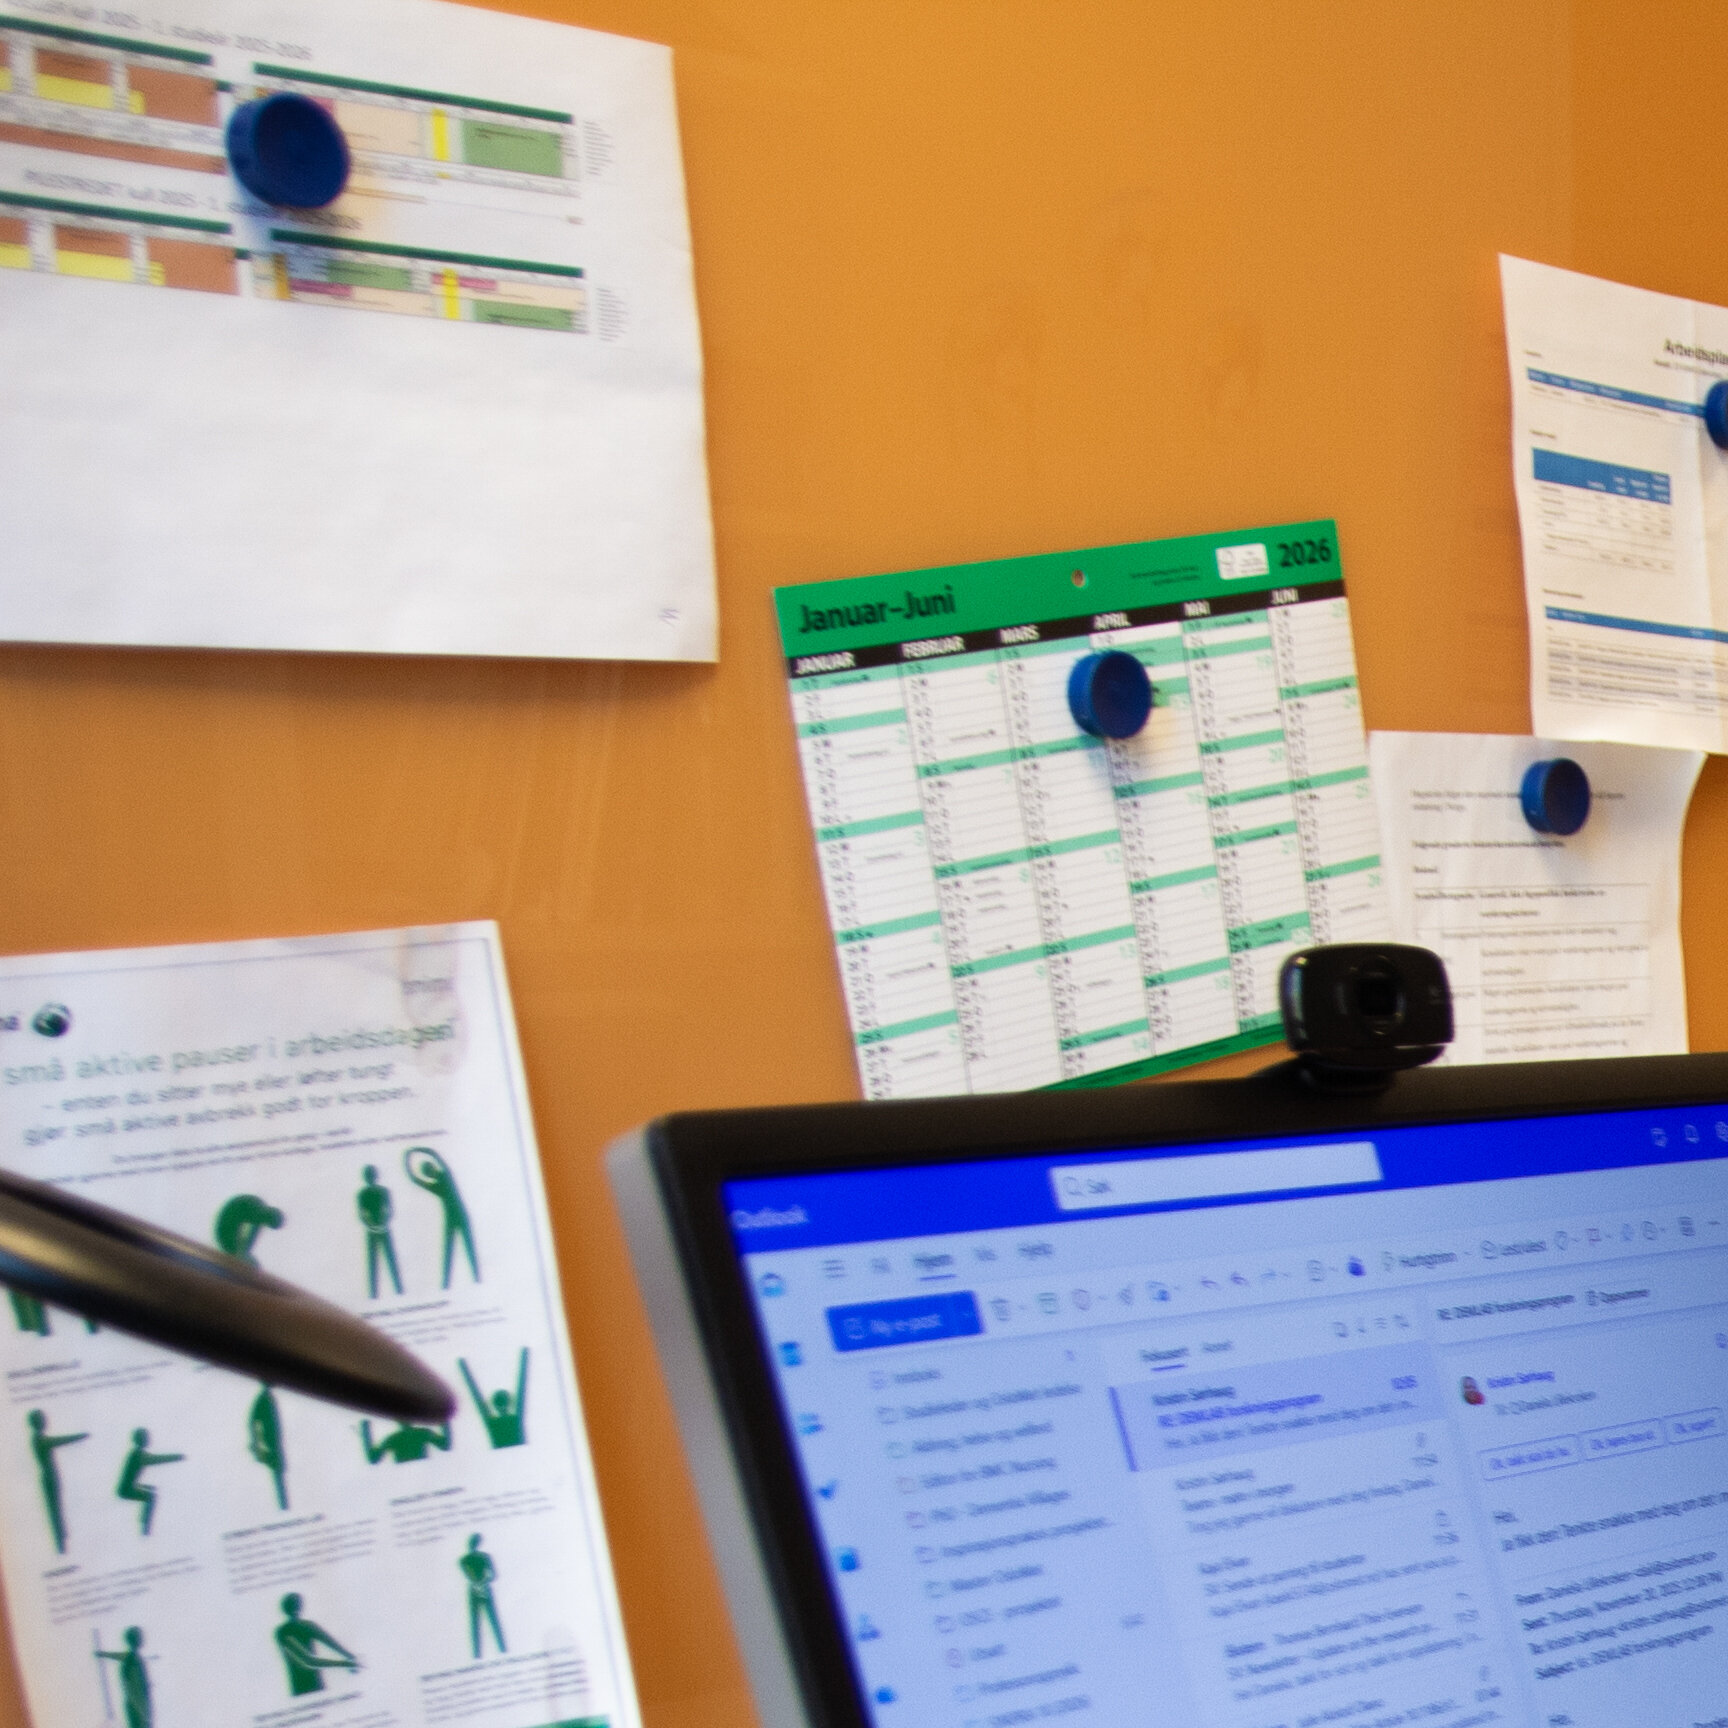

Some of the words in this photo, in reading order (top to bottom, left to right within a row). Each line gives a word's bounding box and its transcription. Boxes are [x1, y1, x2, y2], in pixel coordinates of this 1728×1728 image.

[1278, 538, 1333, 569] 2026
[796, 651, 857, 675] JANUAR
[901, 635, 966, 659] FEBRUAR
[999, 624, 1041, 644] MARS
[1093, 612, 1132, 631] APRIL
[1184, 601, 1211, 617] MAI
[1272, 587, 1299, 605] JUNI
[4, 1056, 66, 1085] små
[75, 1051, 162, 1079] aktive
[172, 1042, 259, 1076] pauser
[286, 1022, 455, 1057] arbeidsdagen
[60, 1094, 121, 1112] enten
[125, 1088, 152, 1105] du
[157, 1084, 204, 1101] sitter
[210, 1080, 249, 1098] mye
[254, 1074, 291, 1092] eller
[22, 1125, 66, 1148] gjør
[73, 1117, 118, 1138] små
[121, 1113, 181, 1133] aktive
[262, 1097, 302, 1119] godt
[731, 1204, 809, 1229] Outlook
[914, 1254, 953, 1271] Hjem
